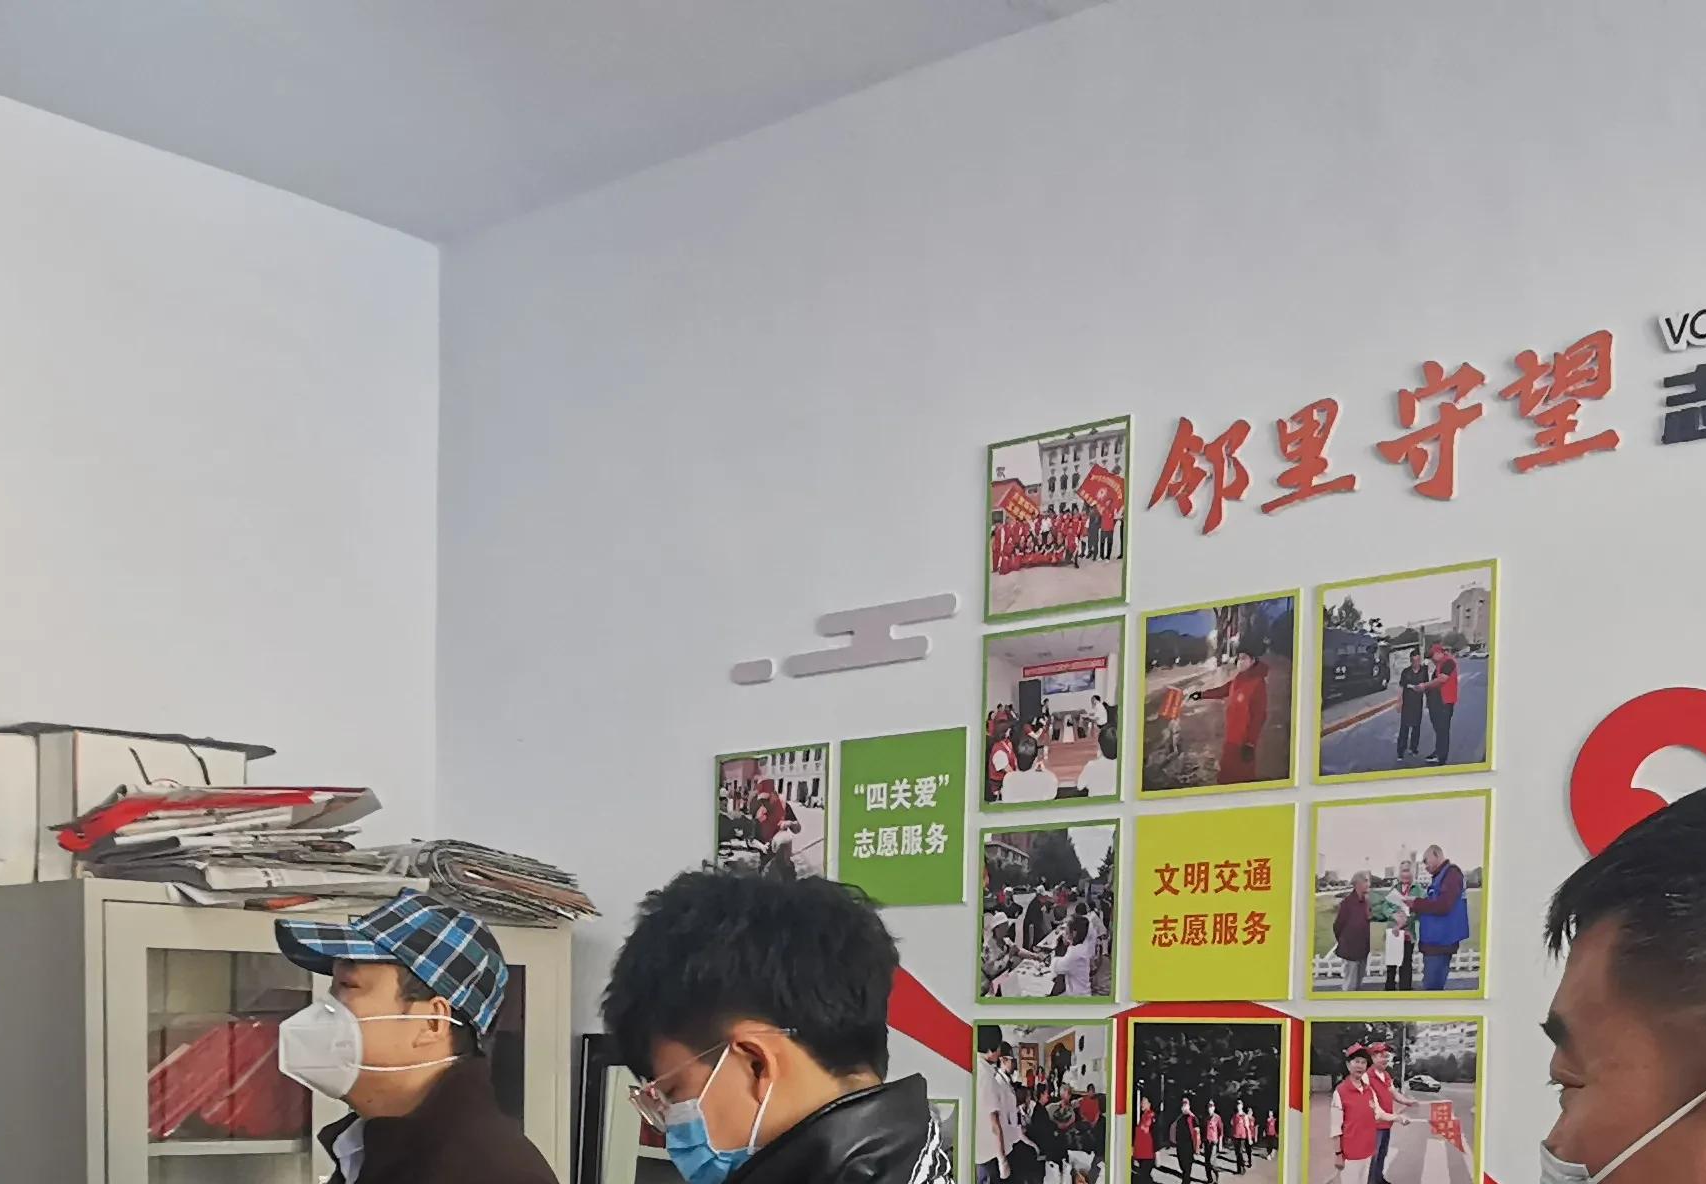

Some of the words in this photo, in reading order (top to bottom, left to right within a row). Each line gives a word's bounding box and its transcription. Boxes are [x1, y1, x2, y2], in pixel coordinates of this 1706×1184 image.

[1147, 329, 1620, 535] 邻里守望
[853, 773, 950, 810] “四关爱”
[852, 822, 948, 860] 志愿服务
[1153, 858, 1273, 897] 文明交通
[1151, 911, 1272, 950] 志愿服务
